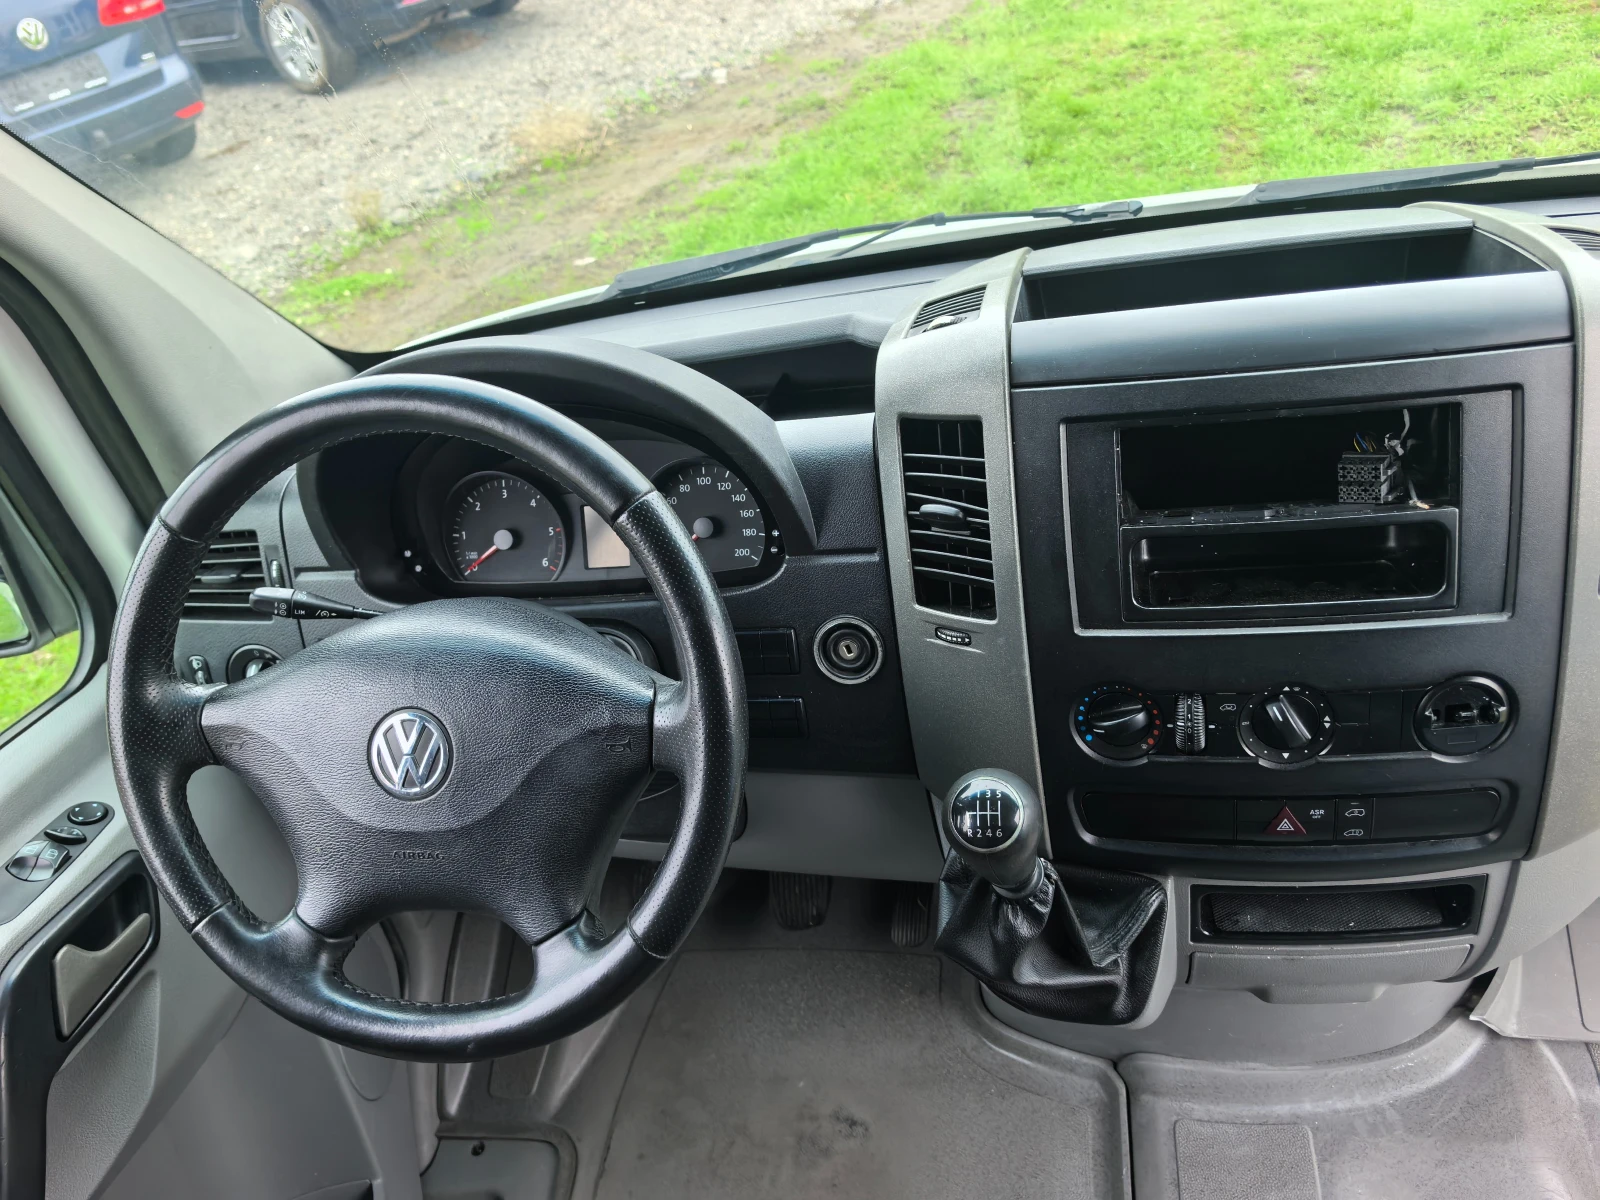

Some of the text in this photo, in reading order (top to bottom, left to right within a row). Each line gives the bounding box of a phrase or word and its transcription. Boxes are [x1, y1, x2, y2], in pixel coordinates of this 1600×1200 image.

[696, 476, 712, 485] 100
[680, 484, 690, 492] 80
[717, 482, 732, 490] 120
[502, 490, 508, 498] 3
[731, 494, 746, 502] 140
[475, 502, 480, 510] 2
[530, 498, 536, 508] 4
[740, 510, 754, 518] 160
[548, 526, 554, 536] 5
[742, 528, 756, 536] 180
[462, 531, 466, 540] 1
[734, 548, 750, 556] 200
[542, 558, 548, 566] 6
[369, 708, 452, 799] VW
[985, 789, 991, 798] 3
[996, 789, 1002, 798] 5
[967, 828, 1003, 838] R 2 4 6
[393, 850, 445, 860] AIRBAG
